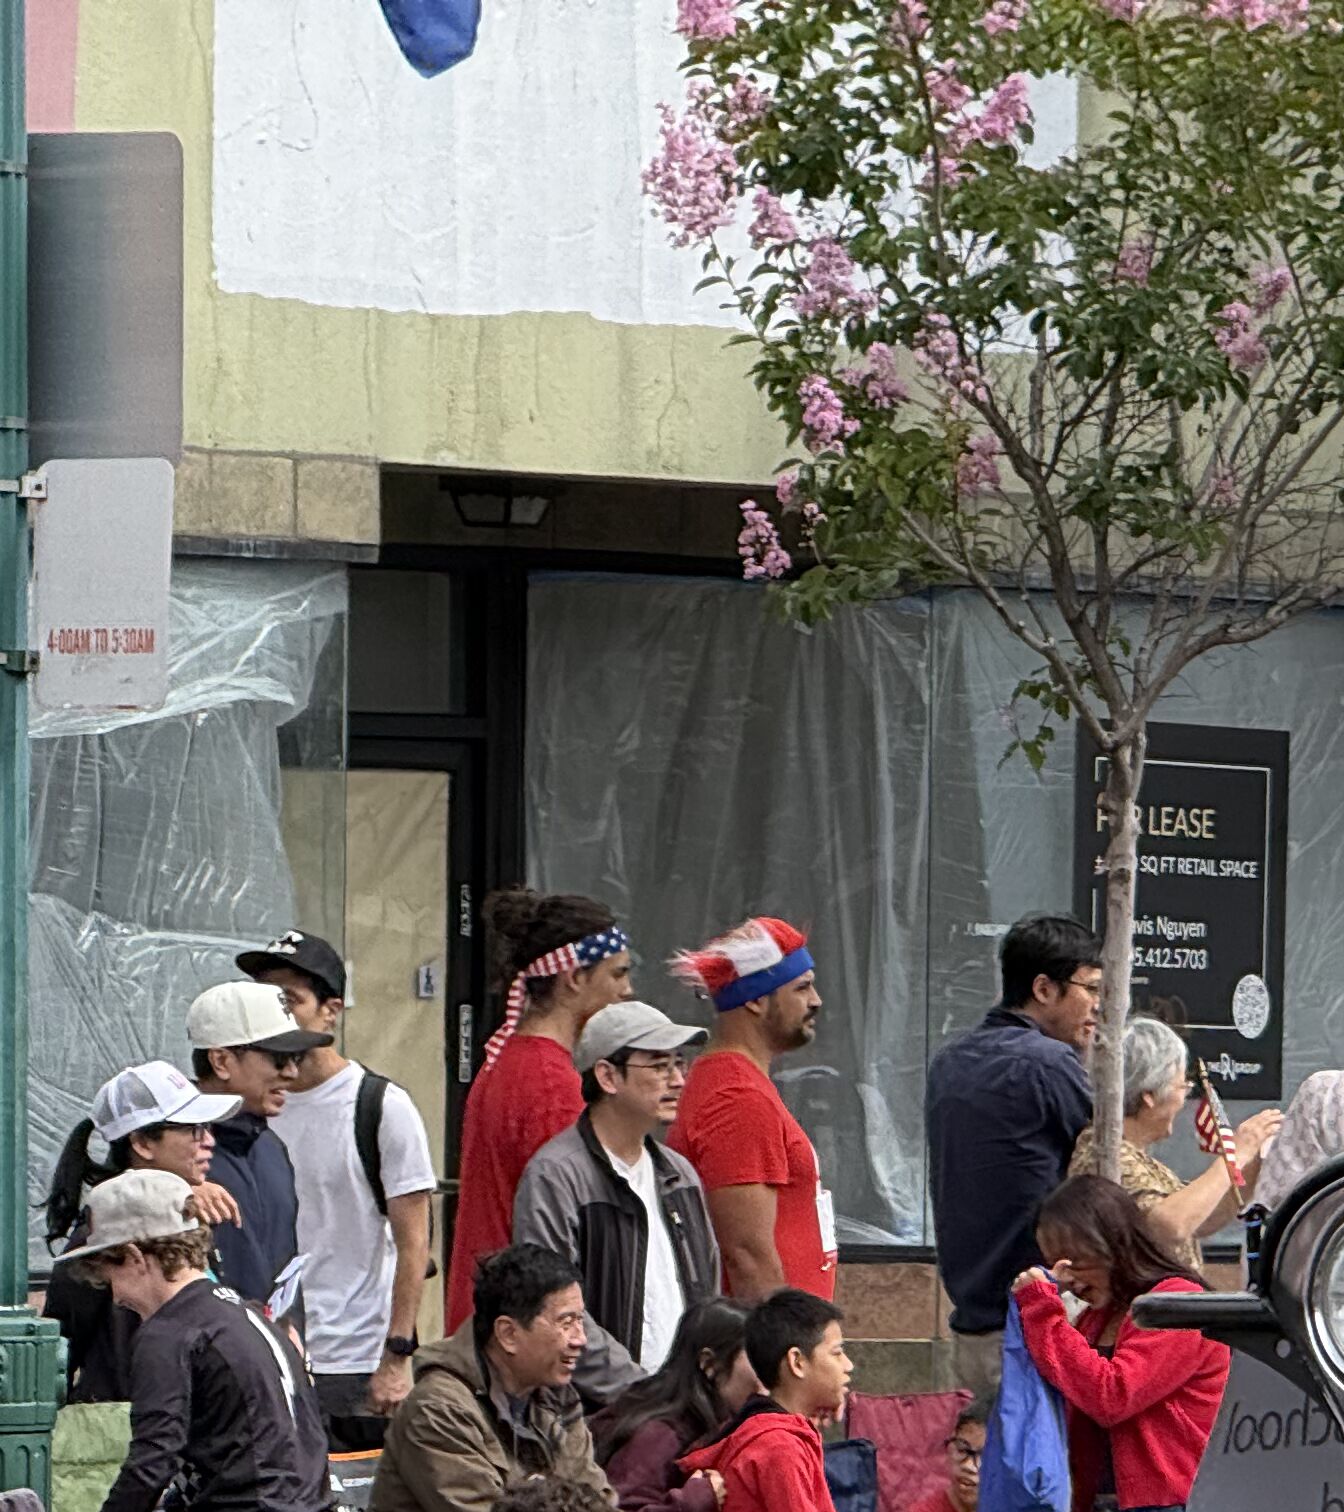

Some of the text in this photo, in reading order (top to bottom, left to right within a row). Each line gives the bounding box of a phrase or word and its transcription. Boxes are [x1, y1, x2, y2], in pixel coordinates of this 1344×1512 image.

[47, 628, 155, 654] 4:00AM TO 5:30AM
[1096, 803, 1216, 839] FR LEASE
[1140, 855, 1159, 875] SQ
[1160, 856, 1176, 873] FT
[1177, 857, 1218, 877] RETAIL
[1219, 859, 1259, 878] SPACE
[1156, 916, 1208, 940] Nguyen
[1133, 947, 1208, 970] 5.412.5703
